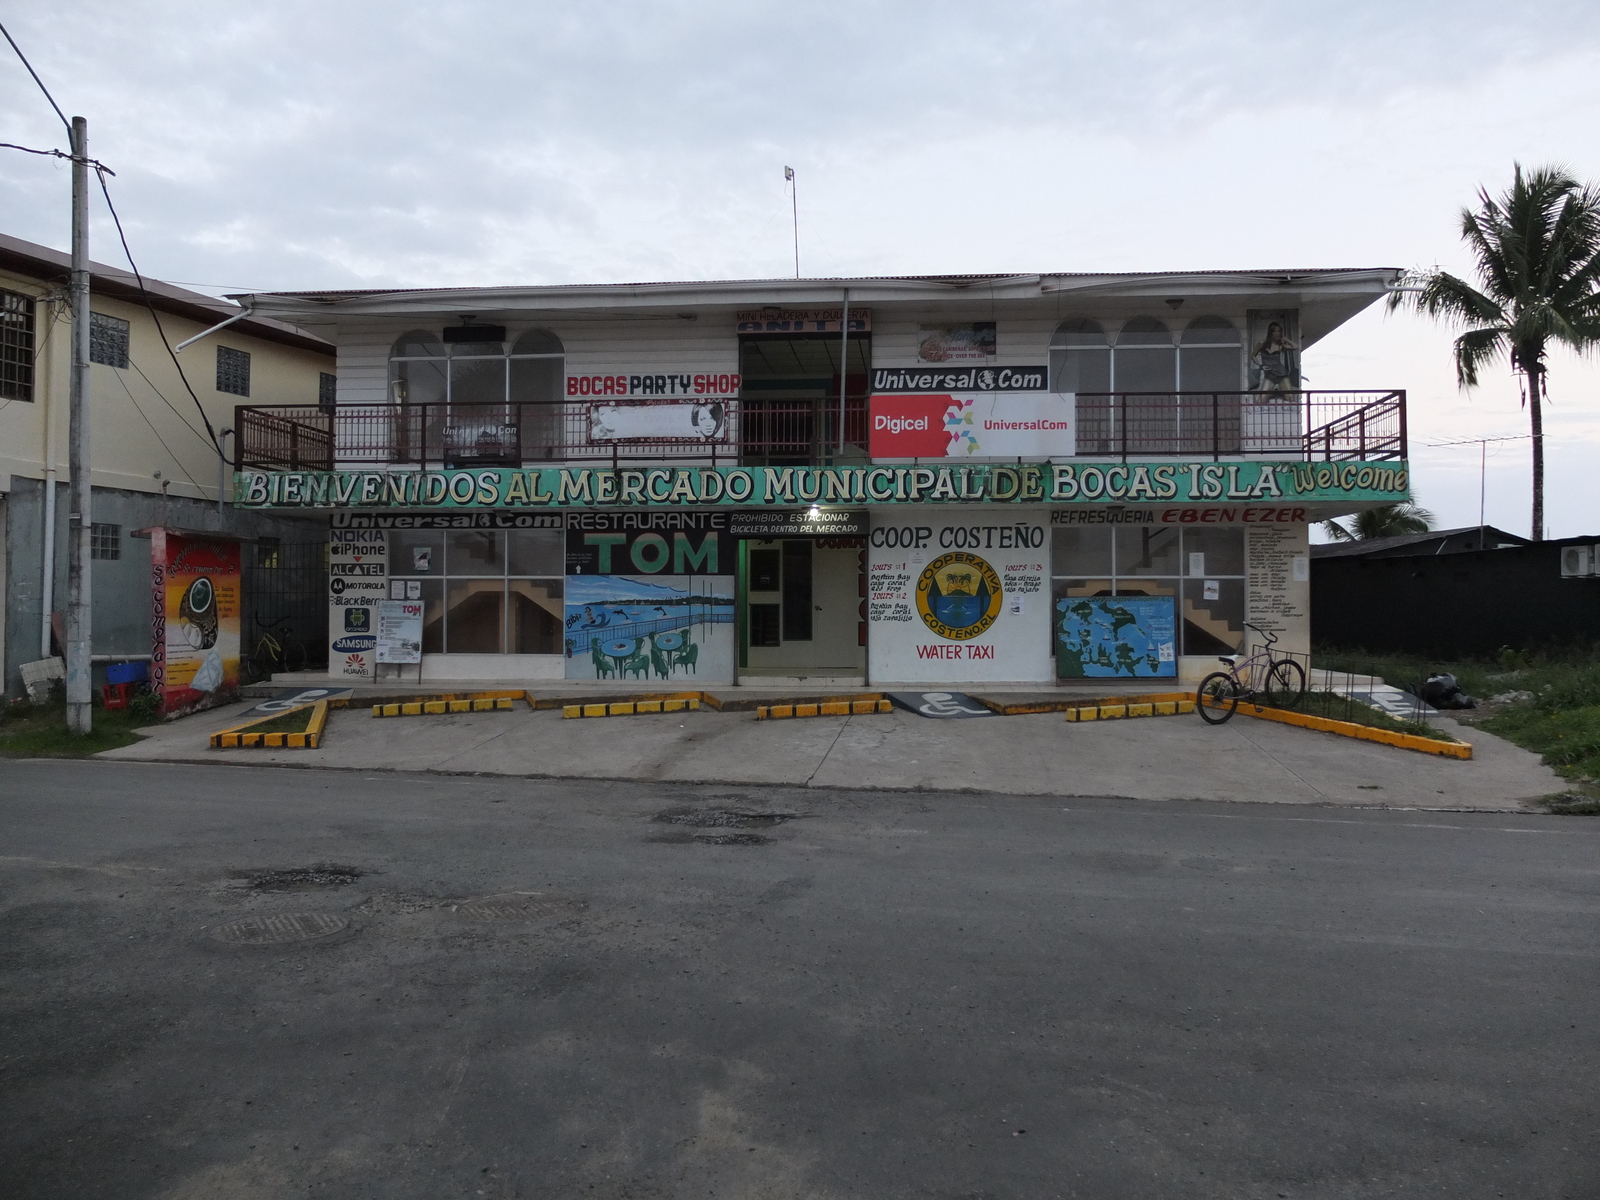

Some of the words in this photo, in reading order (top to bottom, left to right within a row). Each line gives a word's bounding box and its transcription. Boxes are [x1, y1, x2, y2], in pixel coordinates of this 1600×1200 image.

[736, 312, 757, 322] MINI
[814, 312, 820, 320] Y
[567, 376, 628, 396] BOCAS
[630, 374, 692, 395] PARTY
[694, 374, 742, 395] SHOP
[874, 369, 975, 390] Universal
[998, 369, 1042, 389] Com
[874, 415, 929, 434] Digicel
[984, 419, 1068, 431] UniversalCom
[244, 470, 503, 506] BIENVENIDOS
[504, 471, 553, 505] AL
[557, 468, 758, 505] MERCADO
[763, 466, 984, 504] MUNICIPAL
[987, 466, 1044, 502] DE
[1050, 463, 1179, 501] BOCAS
[1288, 463, 1409, 495] Welcome
[332, 512, 478, 530] Universal
[495, 512, 562, 530] Com
[567, 512, 726, 530] RESTAURANTE
[731, 513, 784, 523] PROHIBIDO
[789, 512, 850, 523] ESTACIONAR
[1049, 510, 1155, 525] REFRESQUERIA
[331, 530, 386, 543] NOKIA
[730, 525, 769, 534] BICICLETA
[770, 525, 798, 533] DENTRO
[799, 525, 814, 533] DEL
[815, 524, 858, 533] MERCADO
[870, 526, 933, 549] COOP.
[939, 521, 1045, 549] COSTEÑO
[341, 543, 386, 556] iPhone
[583, 531, 719, 575] TOM
[333, 566, 383, 576] ALCATEL
[918, 553, 1000, 594] COOPERATIVA
[345, 583, 385, 591] MOTOROLA
[402, 605, 422, 614] TOM
[336, 639, 377, 649] SAMSUNG
[916, 645, 963, 660] WATER
[965, 645, 995, 660] TAXI
[343, 667, 369, 676] HUAWEI
